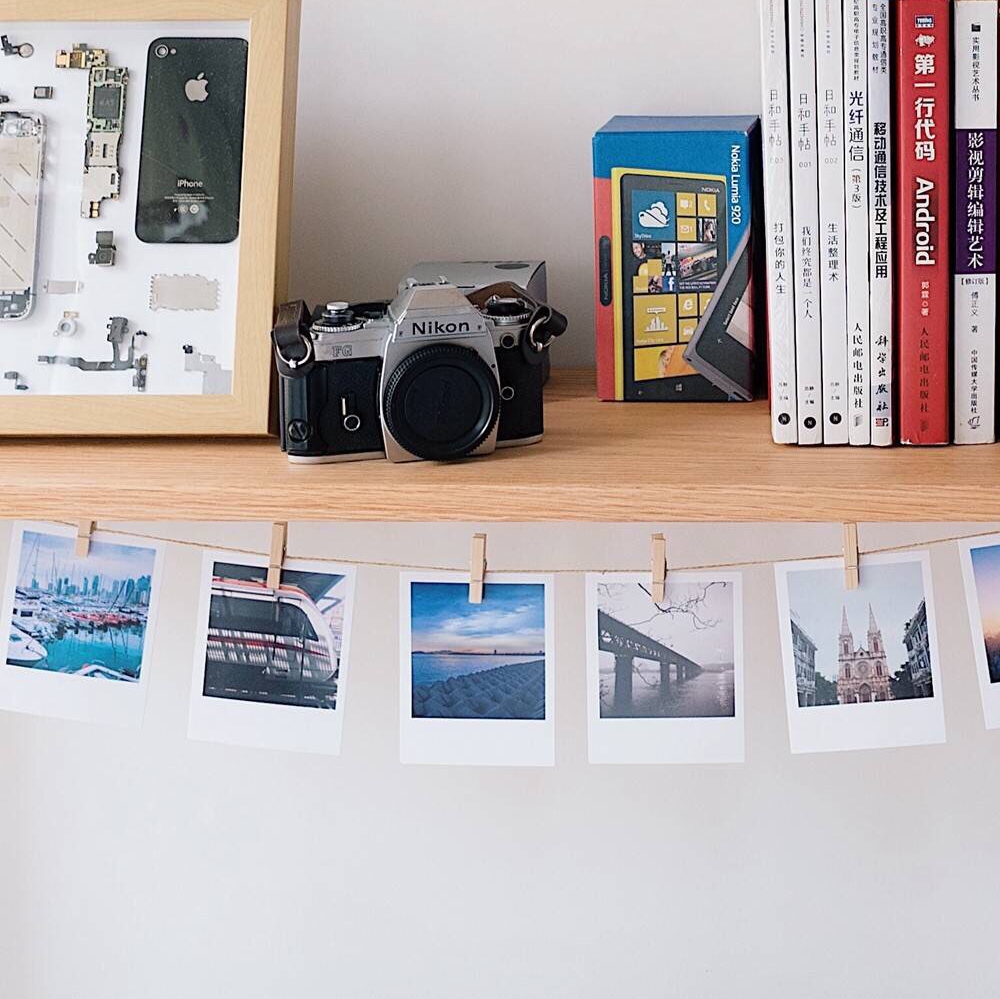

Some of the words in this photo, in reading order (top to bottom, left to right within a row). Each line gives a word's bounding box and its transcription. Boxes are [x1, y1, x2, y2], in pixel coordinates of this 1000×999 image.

[972, 37, 980, 101] 实用影视艺术丛书
[798, 93, 810, 151] 日和手帖
[824, 90, 836, 147] 日和手帖
[849, 91, 864, 162] 光纤通信
[914, 53, 935, 161] 第一行代码
[177, 179, 203, 188] iPhone
[731, 145, 741, 172] Nokia
[731, 174, 741, 204] Lumia
[731, 205, 742, 225] 920
[873, 122, 888, 278] 移动通信技术及工程应用
[915, 177, 935, 266] Android
[967, 132, 984, 269] 影视剪辑编辑艺术
[774, 222, 786, 294] 打包你的人生
[802, 226, 813, 319] 我们终究都是一个人
[827, 223, 838, 281] 生活整理术
[412, 320, 470, 335] Nikon
[971, 325, 978, 333] 著
[852, 322, 863, 409] 人民邮电出版社
[919, 327, 929, 413] 人民邮电出版社
